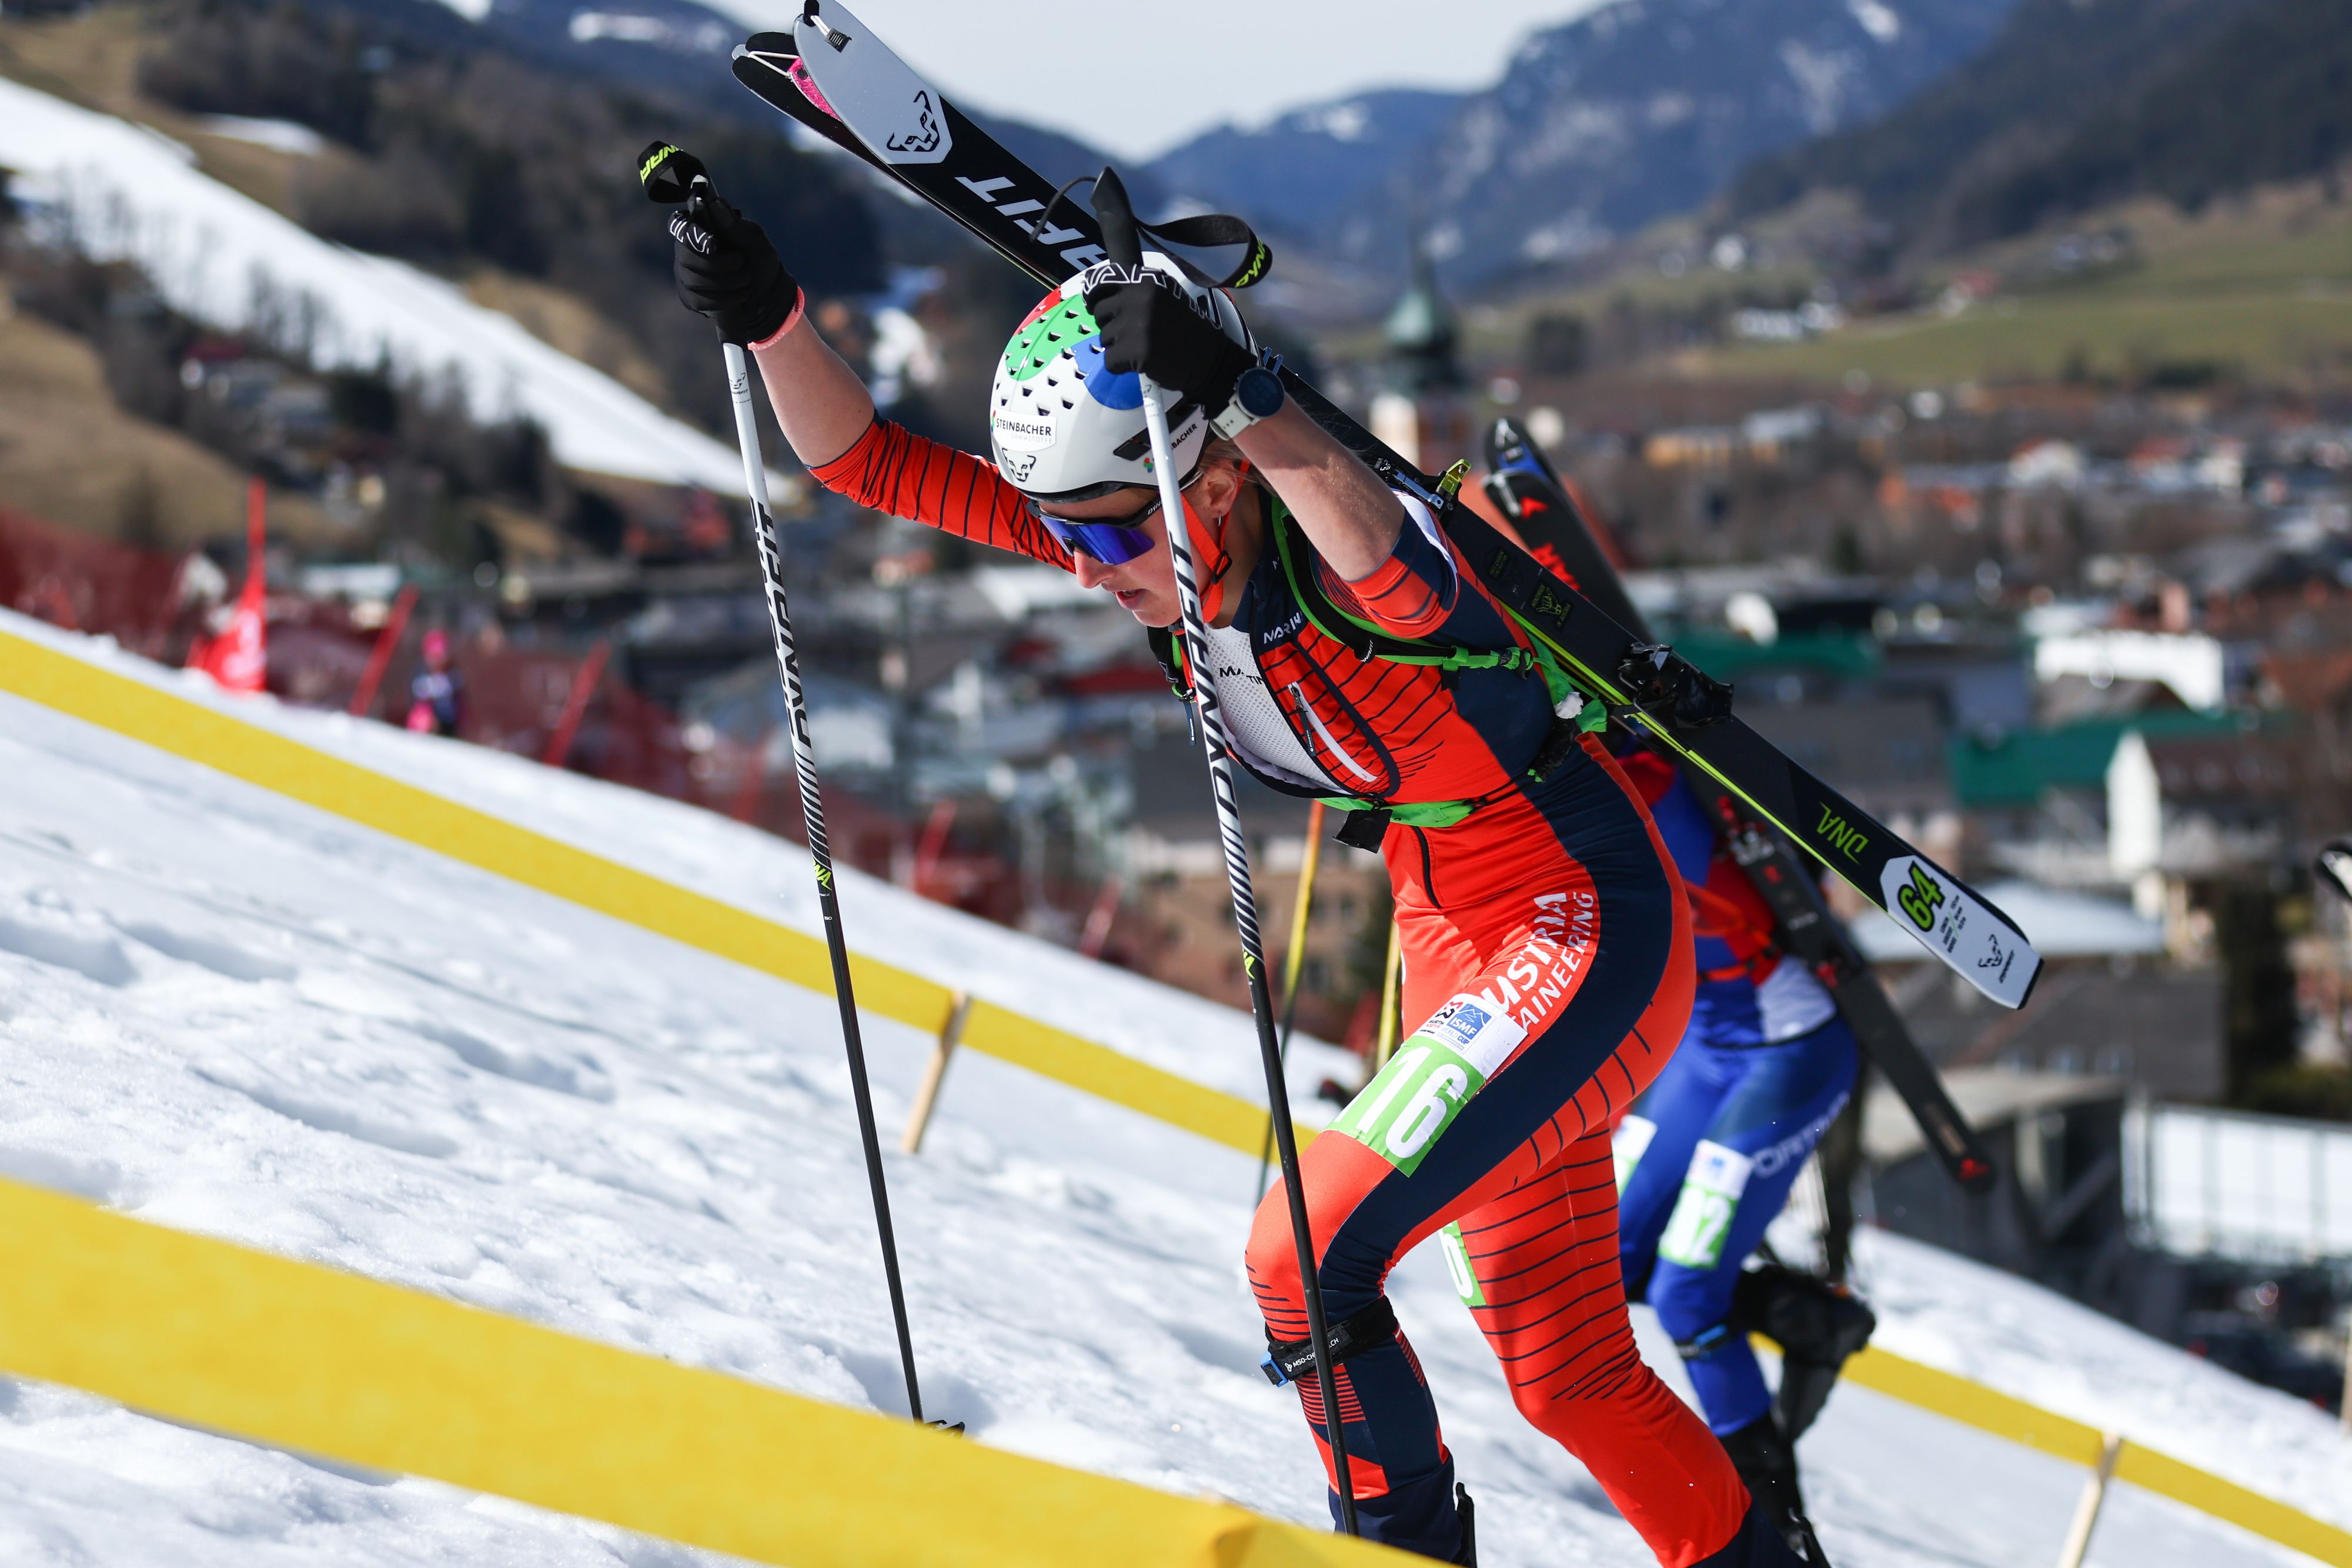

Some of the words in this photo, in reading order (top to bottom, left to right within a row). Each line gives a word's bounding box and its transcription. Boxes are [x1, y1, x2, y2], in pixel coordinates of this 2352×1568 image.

[996, 418, 1052, 436] STEINBACHER
[1171, 423, 1198, 449] BACHER
[1817, 801, 1869, 865] DNA
[1897, 860, 1946, 932] 64
[1481, 892, 1567, 1013] USTRIA
[1519, 891, 1594, 1033] AINEERING
[1449, 1017, 1478, 1038] ISMF
[1457, 1035, 1470, 1045] CUP
[1355, 1045, 1468, 1159] 16
